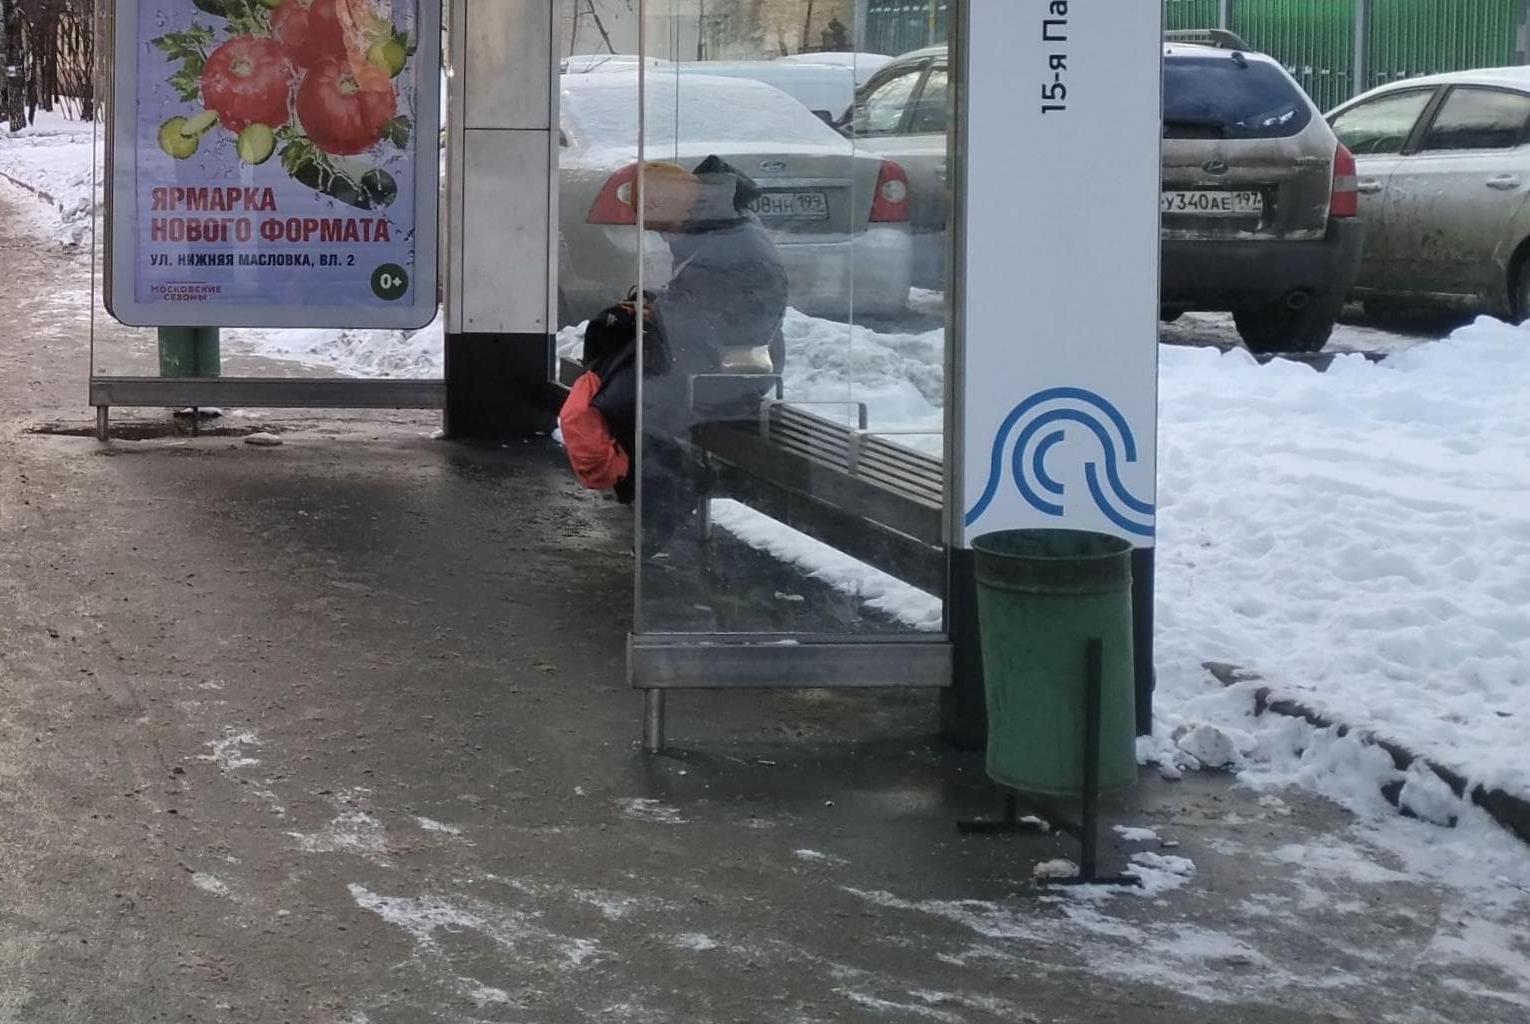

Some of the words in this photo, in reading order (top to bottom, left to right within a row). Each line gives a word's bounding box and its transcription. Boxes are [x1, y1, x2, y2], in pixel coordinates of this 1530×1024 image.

[1041, 55, 1067, 114] 15-я
[151, 187, 277, 211] ЯРМАРКА
[150, 217, 252, 242] НОВОГО
[260, 217, 391, 242] ФОРМАТА
[150, 254, 173, 266] УЛ.
[178, 254, 234, 266] НИЖНЯЯ
[238, 254, 315, 268] МАСЛОВКА,
[320, 255, 342, 266] ВЛ.
[347, 255, 355, 266] 2
[380, 274, 402, 289] 0+
